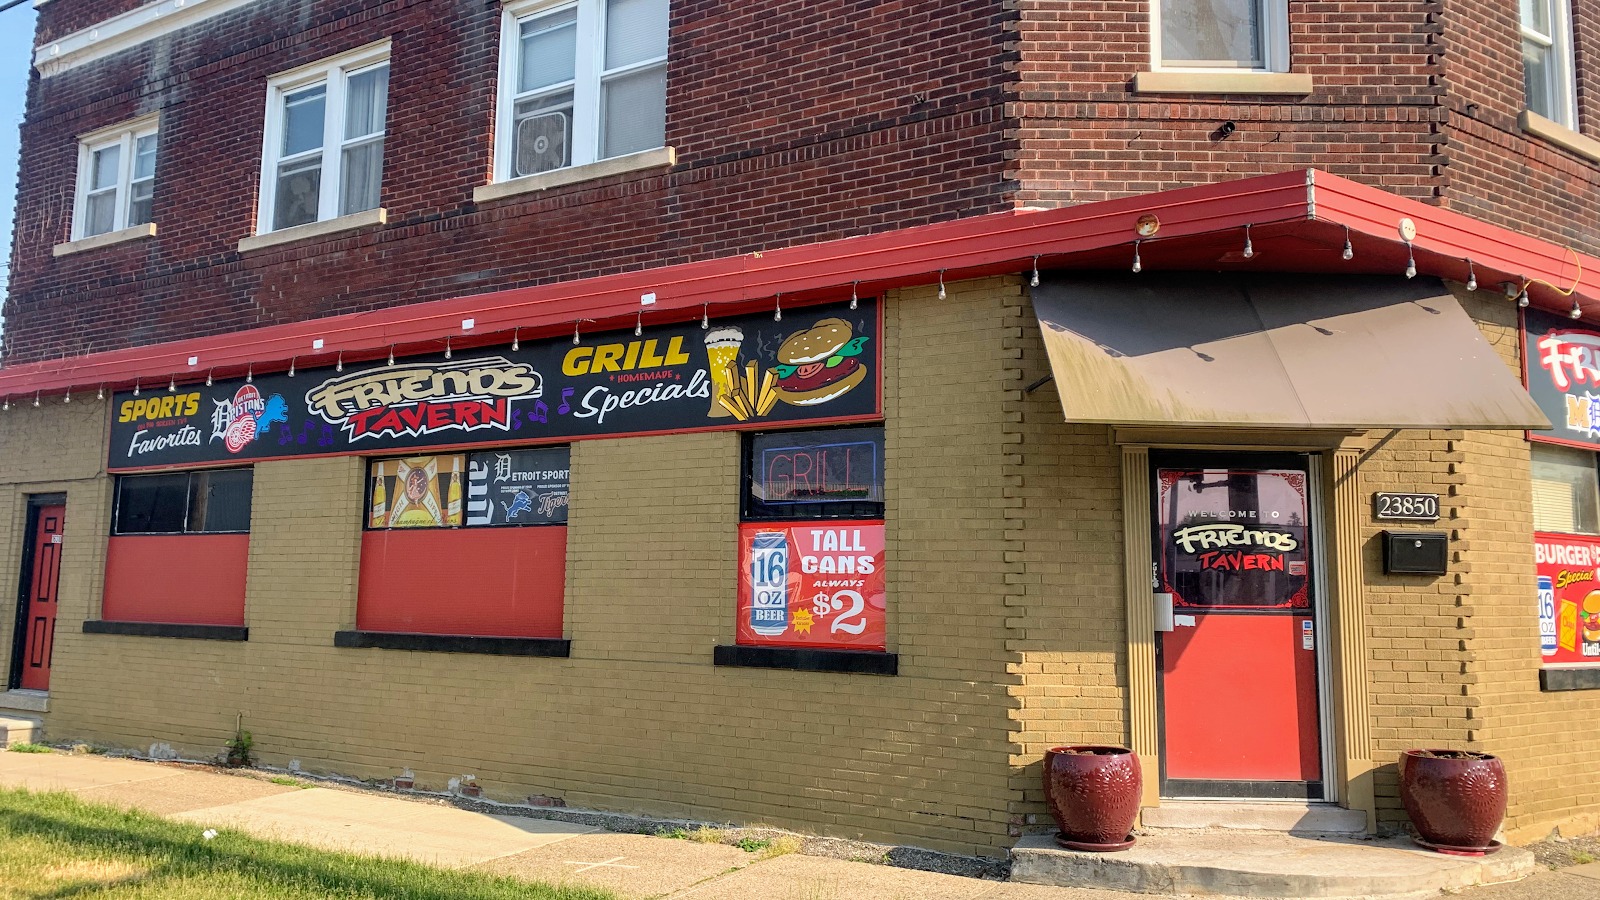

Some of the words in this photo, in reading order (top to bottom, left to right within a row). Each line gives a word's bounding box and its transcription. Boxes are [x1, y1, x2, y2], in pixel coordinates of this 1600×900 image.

[562, 336, 690, 376] GRILL
[617, 369, 673, 383] HOMEMADE
[573, 368, 711, 424] Specials
[118, 392, 200, 423] SPORTS
[228, 398, 265, 421] PISTONS
[348, 399, 507, 436] TAVERN
[127, 425, 201, 458] Favorites
[542, 470, 570, 480] SPORT
[769, 448, 869, 497] GRILL
[1189, 510, 1256, 518] WELCOME
[1264, 510, 1280, 518] TO
[1380, 496, 1436, 516] 23850
[810, 530, 866, 552] TALL
[801, 555, 875, 574] CANS
[1200, 551, 1284, 571] TAVERN
[1535, 543, 1592, 566] BURGER
[756, 551, 784, 588] 16
[1556, 569, 1594, 589] Special
[812, 579, 865, 588] ALWAYS
[757, 591, 782, 605] OZ
[1538, 592, 1553, 619] 16
[755, 609, 785, 621] BEER
[812, 590, 867, 635] $2
[1541, 622, 1554, 633] OZ
